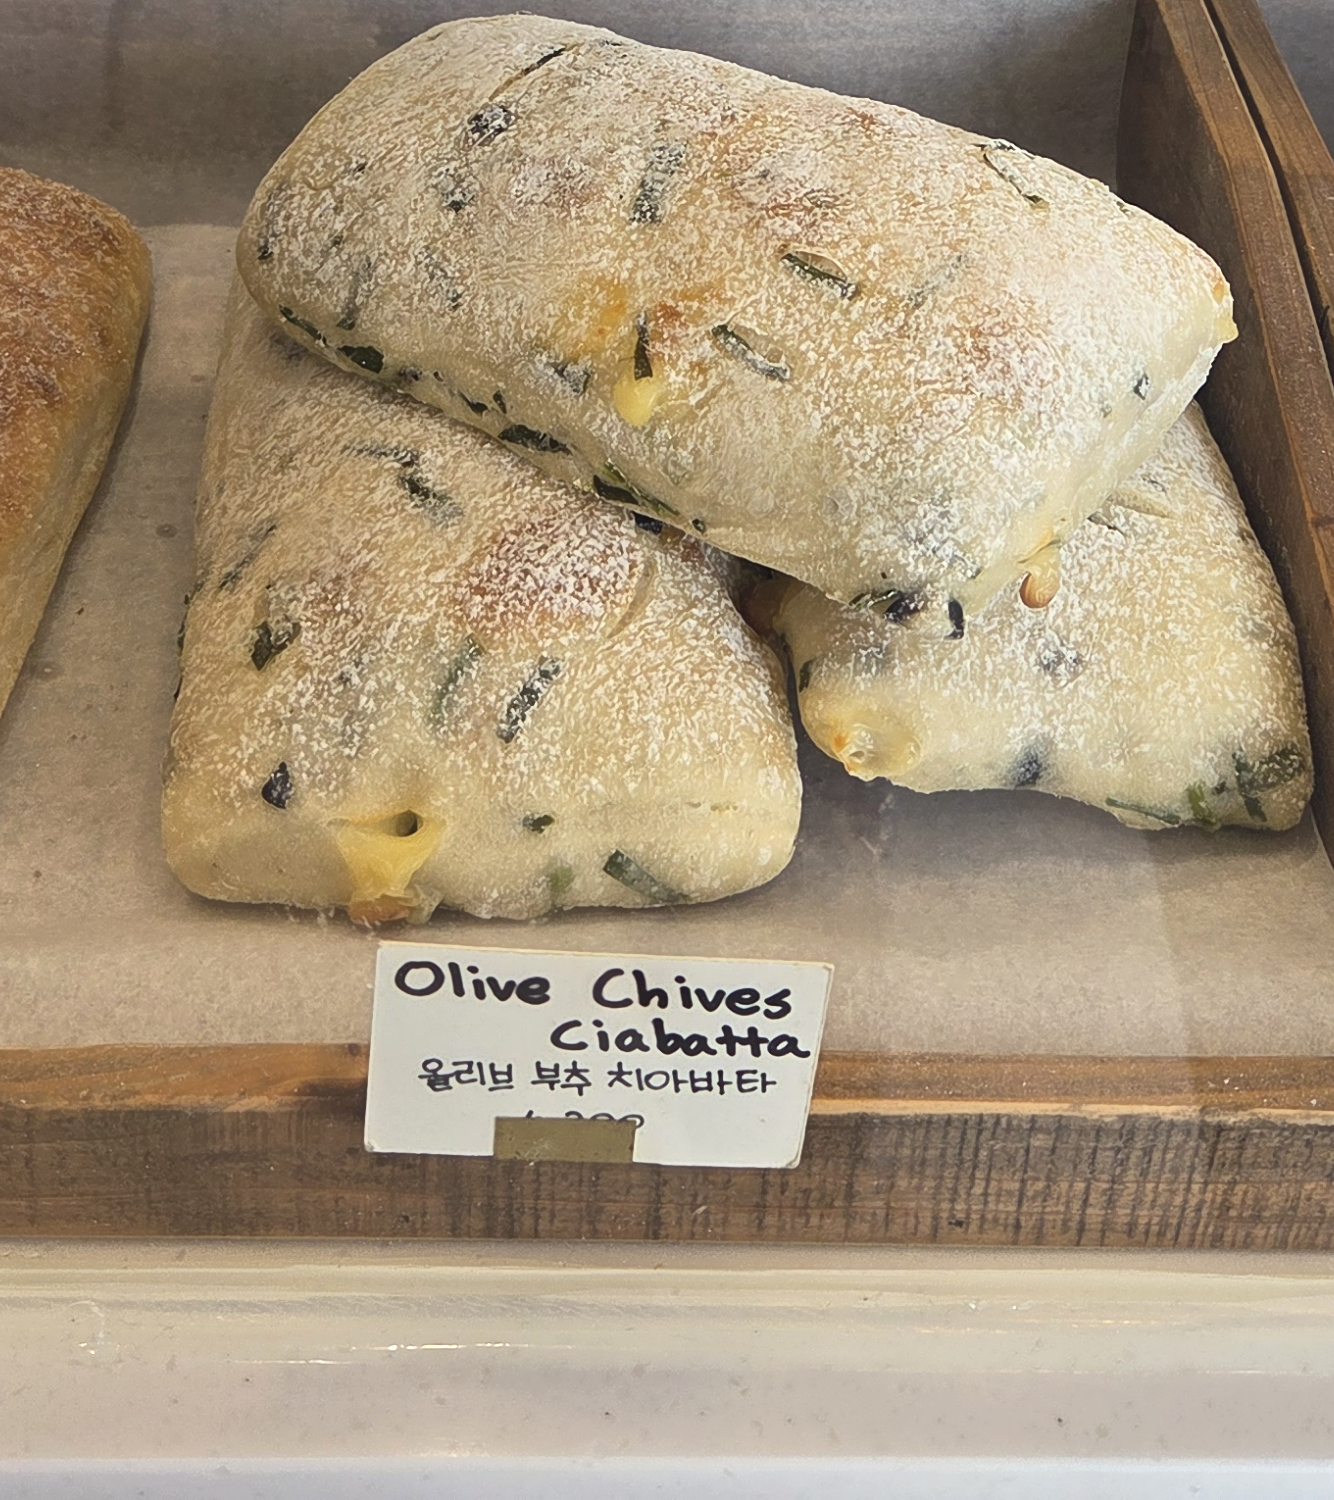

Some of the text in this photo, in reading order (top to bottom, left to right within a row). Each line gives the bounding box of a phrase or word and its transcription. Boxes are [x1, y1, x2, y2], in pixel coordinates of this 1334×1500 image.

[394, 959, 792, 1020] Olive Chives
[550, 1017, 812, 1059] Ciabatta
[417, 1058, 778, 1097] 올리브 부추 치아바타
